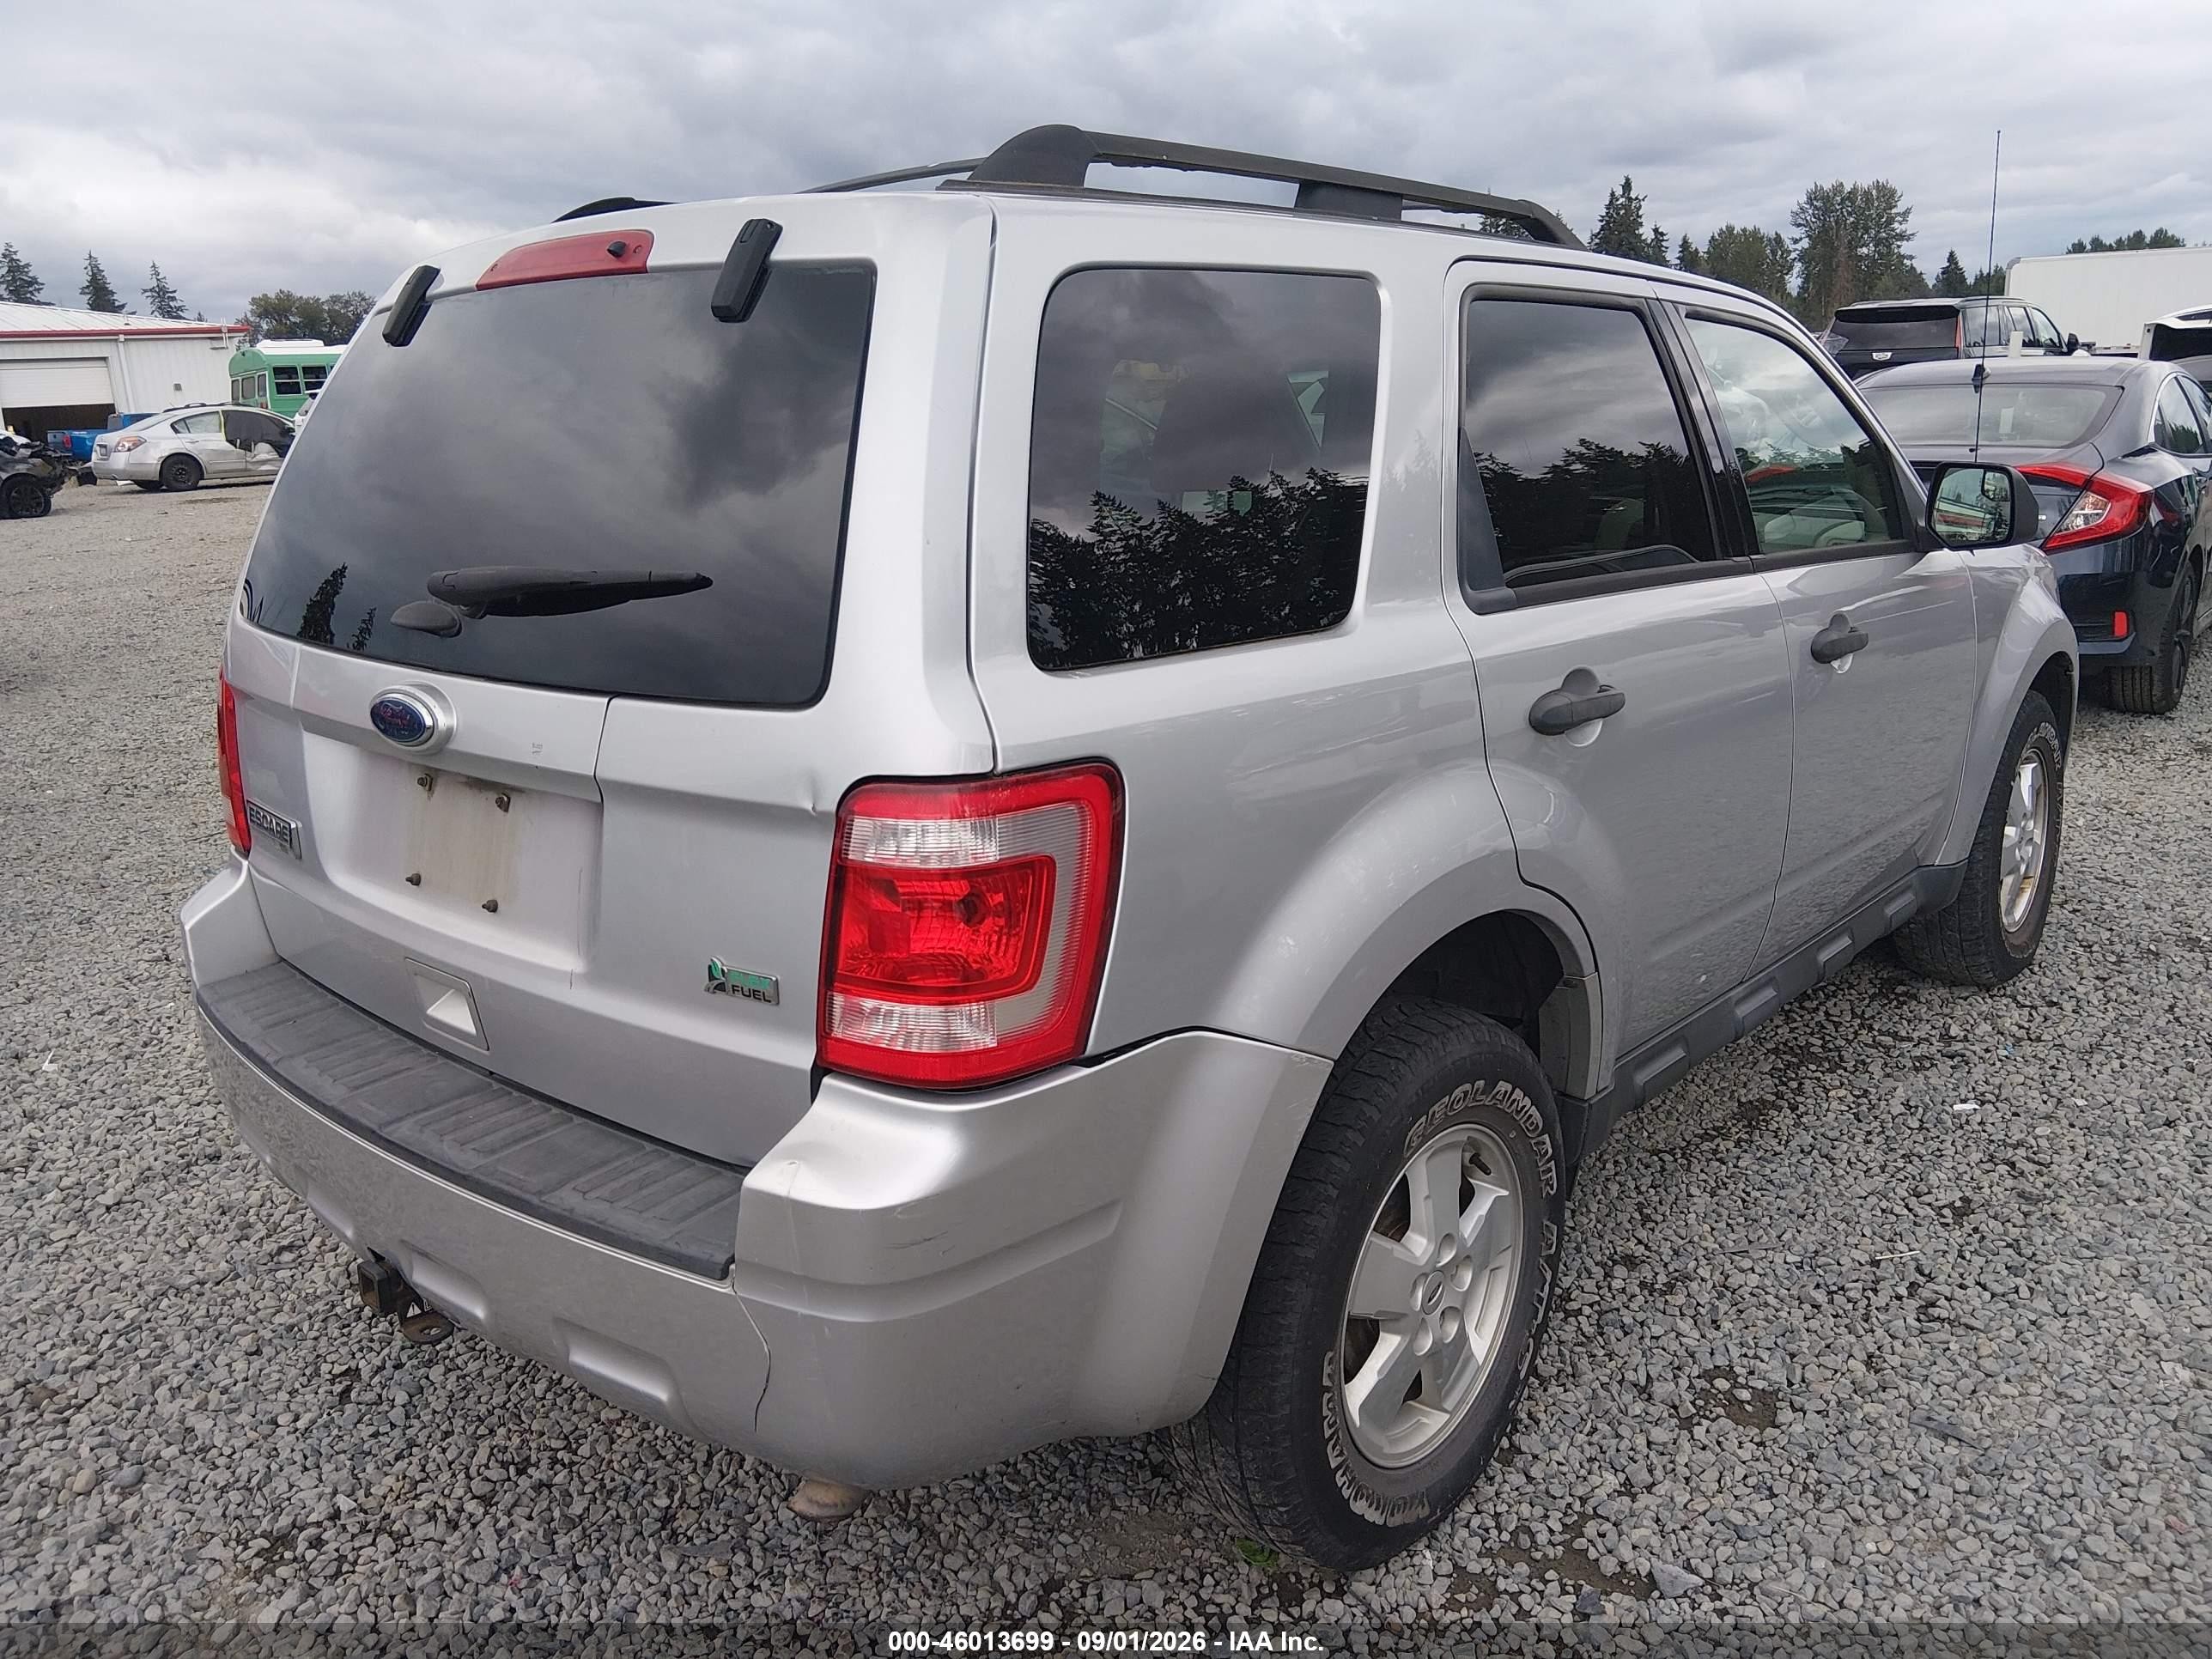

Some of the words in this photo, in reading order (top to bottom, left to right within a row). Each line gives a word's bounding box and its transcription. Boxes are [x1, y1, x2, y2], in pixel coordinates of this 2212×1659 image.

[248, 805, 289, 844] ESCAPE
[728, 970, 771, 990] FLEX
[731, 984, 772, 1004] FUEL
[1404, 1079, 1558, 1199] GEOLANDAR
